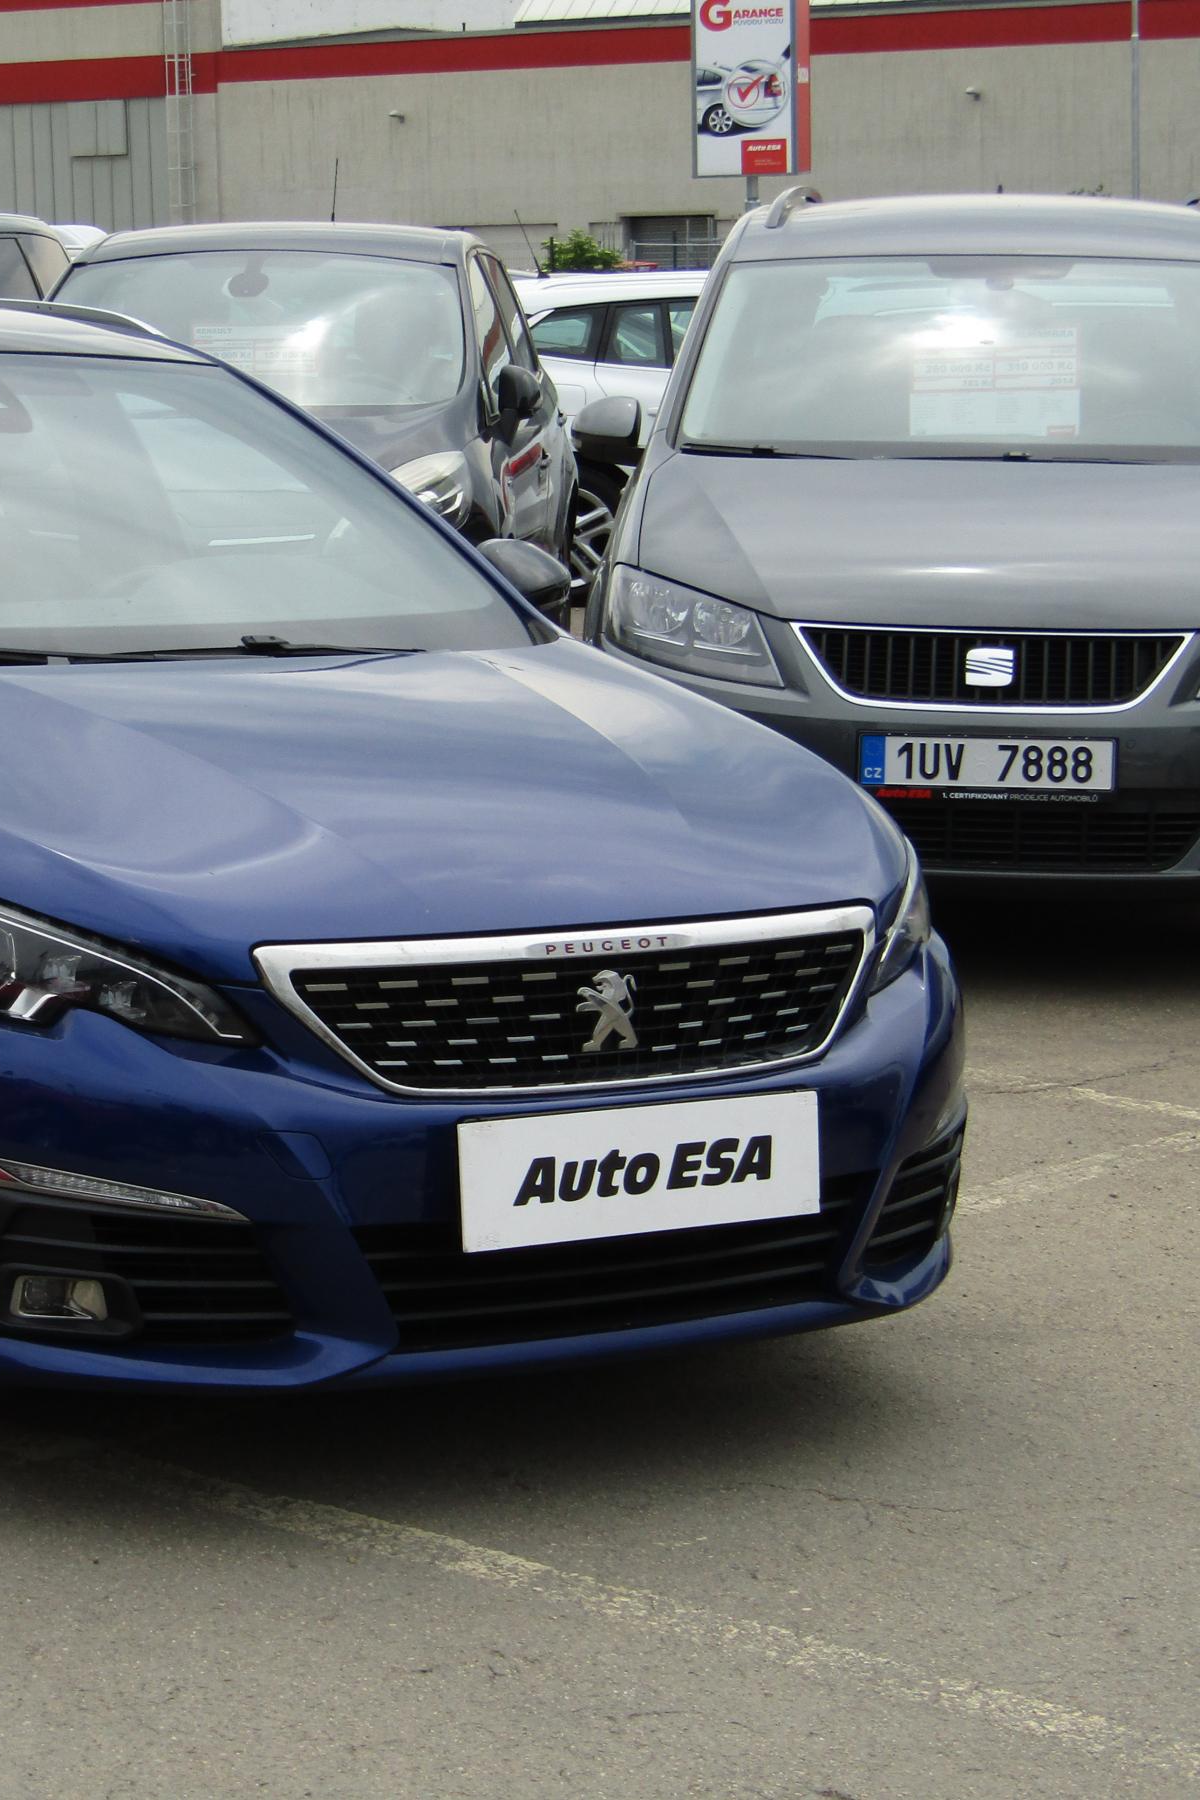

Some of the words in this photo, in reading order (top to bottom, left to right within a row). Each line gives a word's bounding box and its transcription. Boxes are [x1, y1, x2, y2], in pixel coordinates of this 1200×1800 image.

[699, 0, 784, 32] GARANCE
[864, 767, 882, 779] CZ
[897, 742, 965, 781] 1UV
[997, 744, 1093, 783] 7888
[545, 936, 668, 955] PEUGEOT
[512, 1149, 660, 1207] Auto
[666, 1134, 773, 1191] ESA
